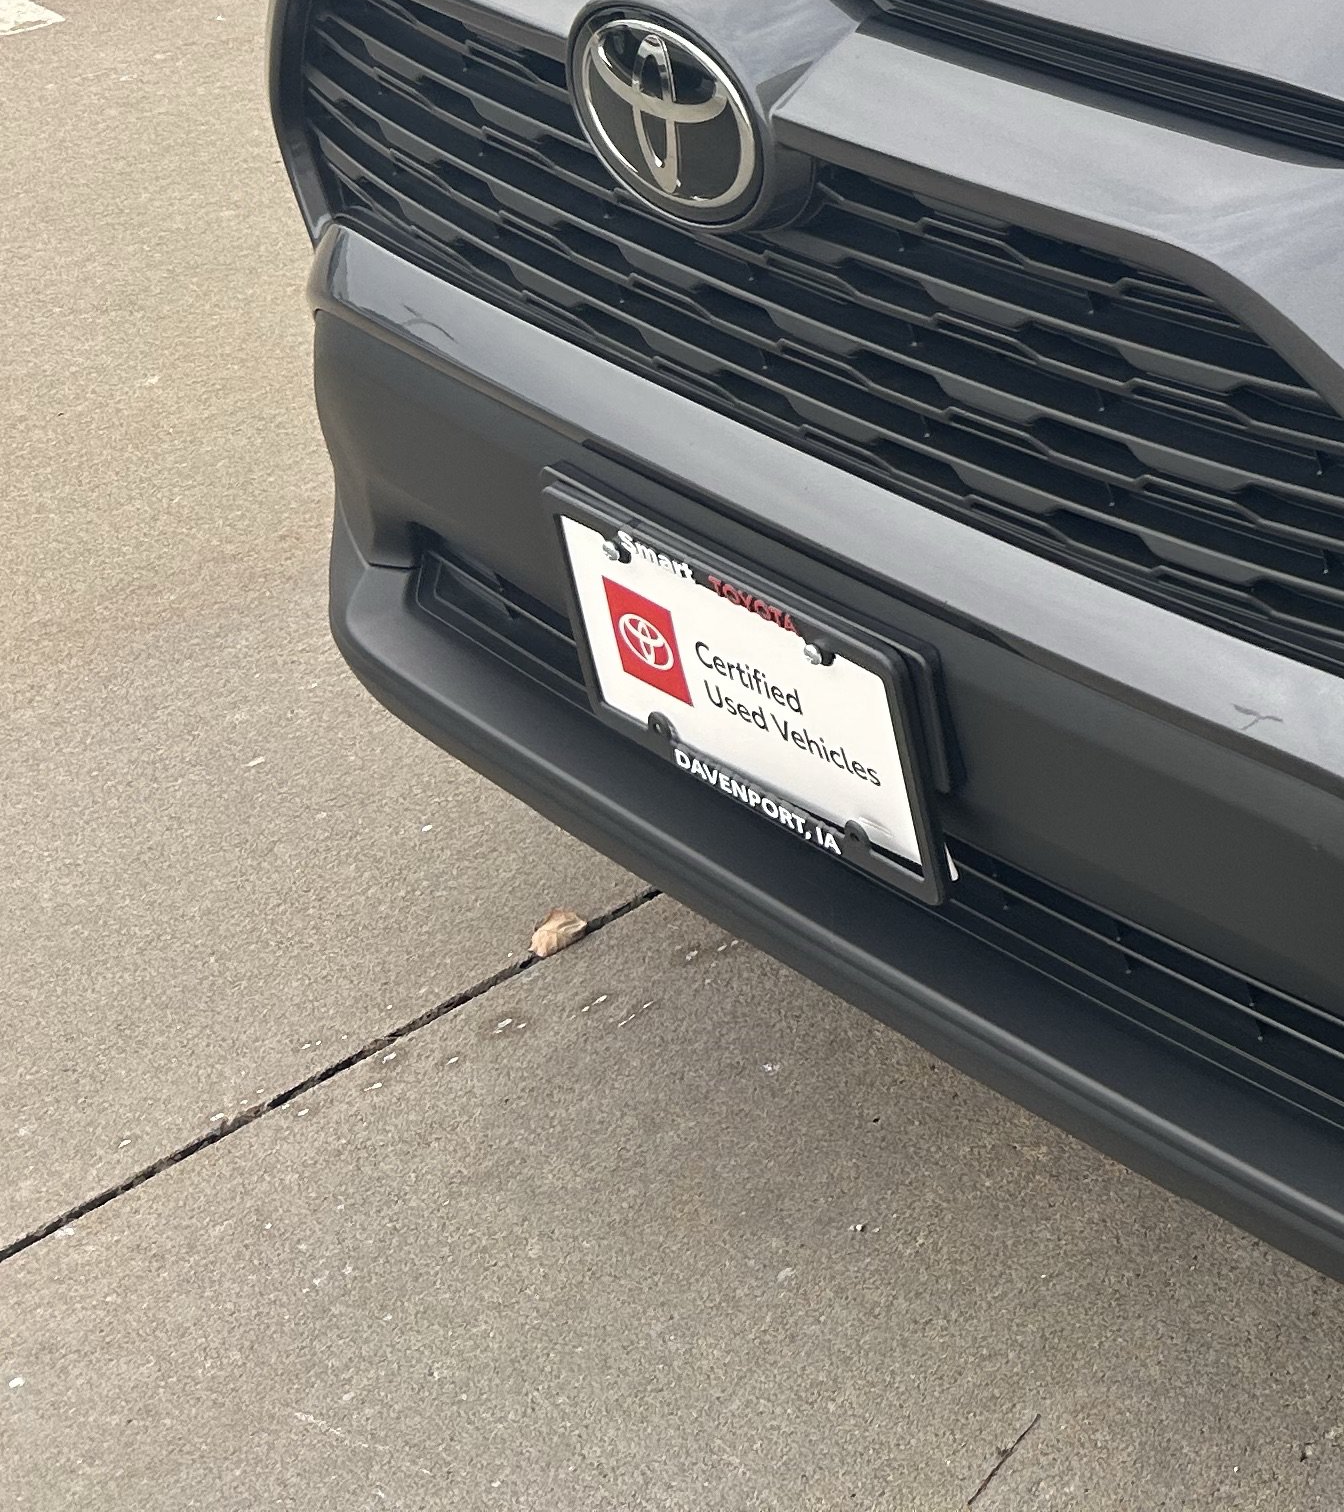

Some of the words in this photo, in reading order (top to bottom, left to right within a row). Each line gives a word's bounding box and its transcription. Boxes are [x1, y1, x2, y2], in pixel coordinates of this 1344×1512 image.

[617, 529, 696, 582] Smart
[707, 574, 799, 634] TOYOTA
[694, 640, 804, 716] Certified
[703, 680, 770, 733] Used
[770, 711, 882, 788] Vehicles
[673, 747, 813, 841] DAVENPORT,
[814, 827, 842, 855] IA
